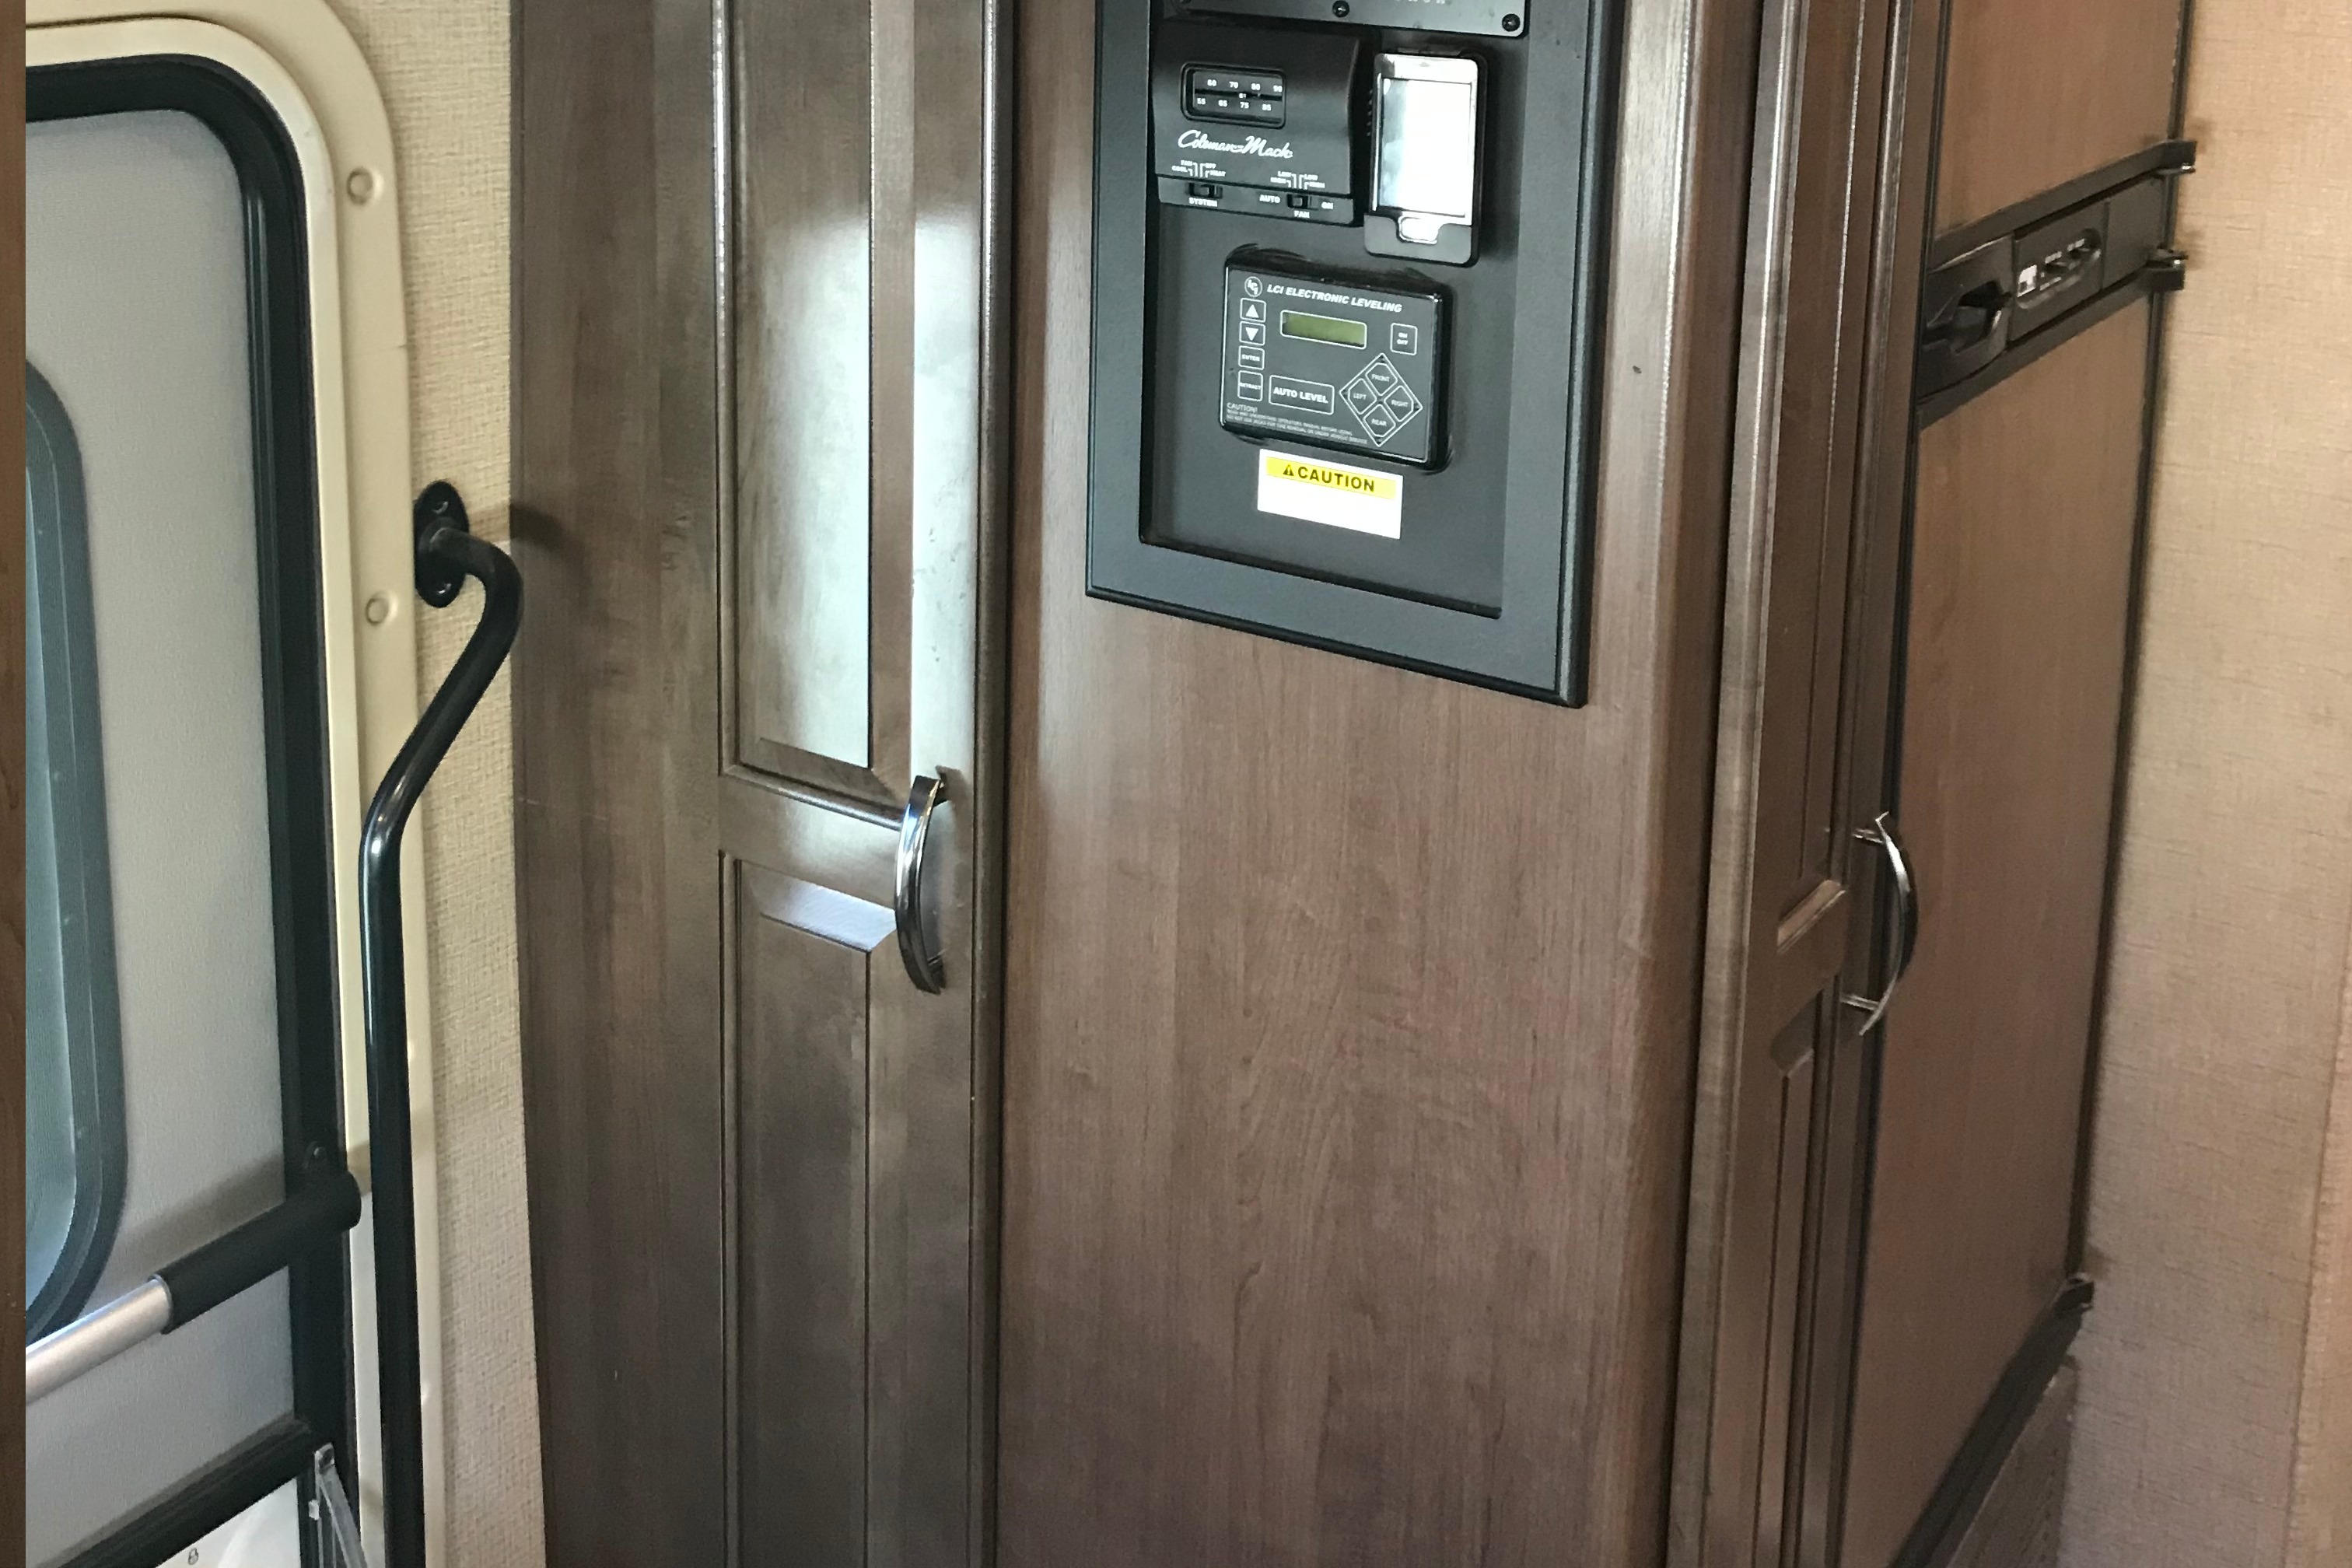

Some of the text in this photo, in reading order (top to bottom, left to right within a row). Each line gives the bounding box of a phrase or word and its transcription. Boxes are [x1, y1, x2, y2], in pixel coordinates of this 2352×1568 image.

[1188, 197, 1218, 208] SYSTEM
[1259, 194, 1281, 204] AUTO
[1293, 210, 1310, 219] FAN
[1266, 283, 1403, 313] LCI ELECTRONIC LEVELING
[1371, 374, 1391, 383] FRONT
[1272, 387, 1329, 404] AUTO LEVEL
[1297, 466, 1375, 493] CAUTION
